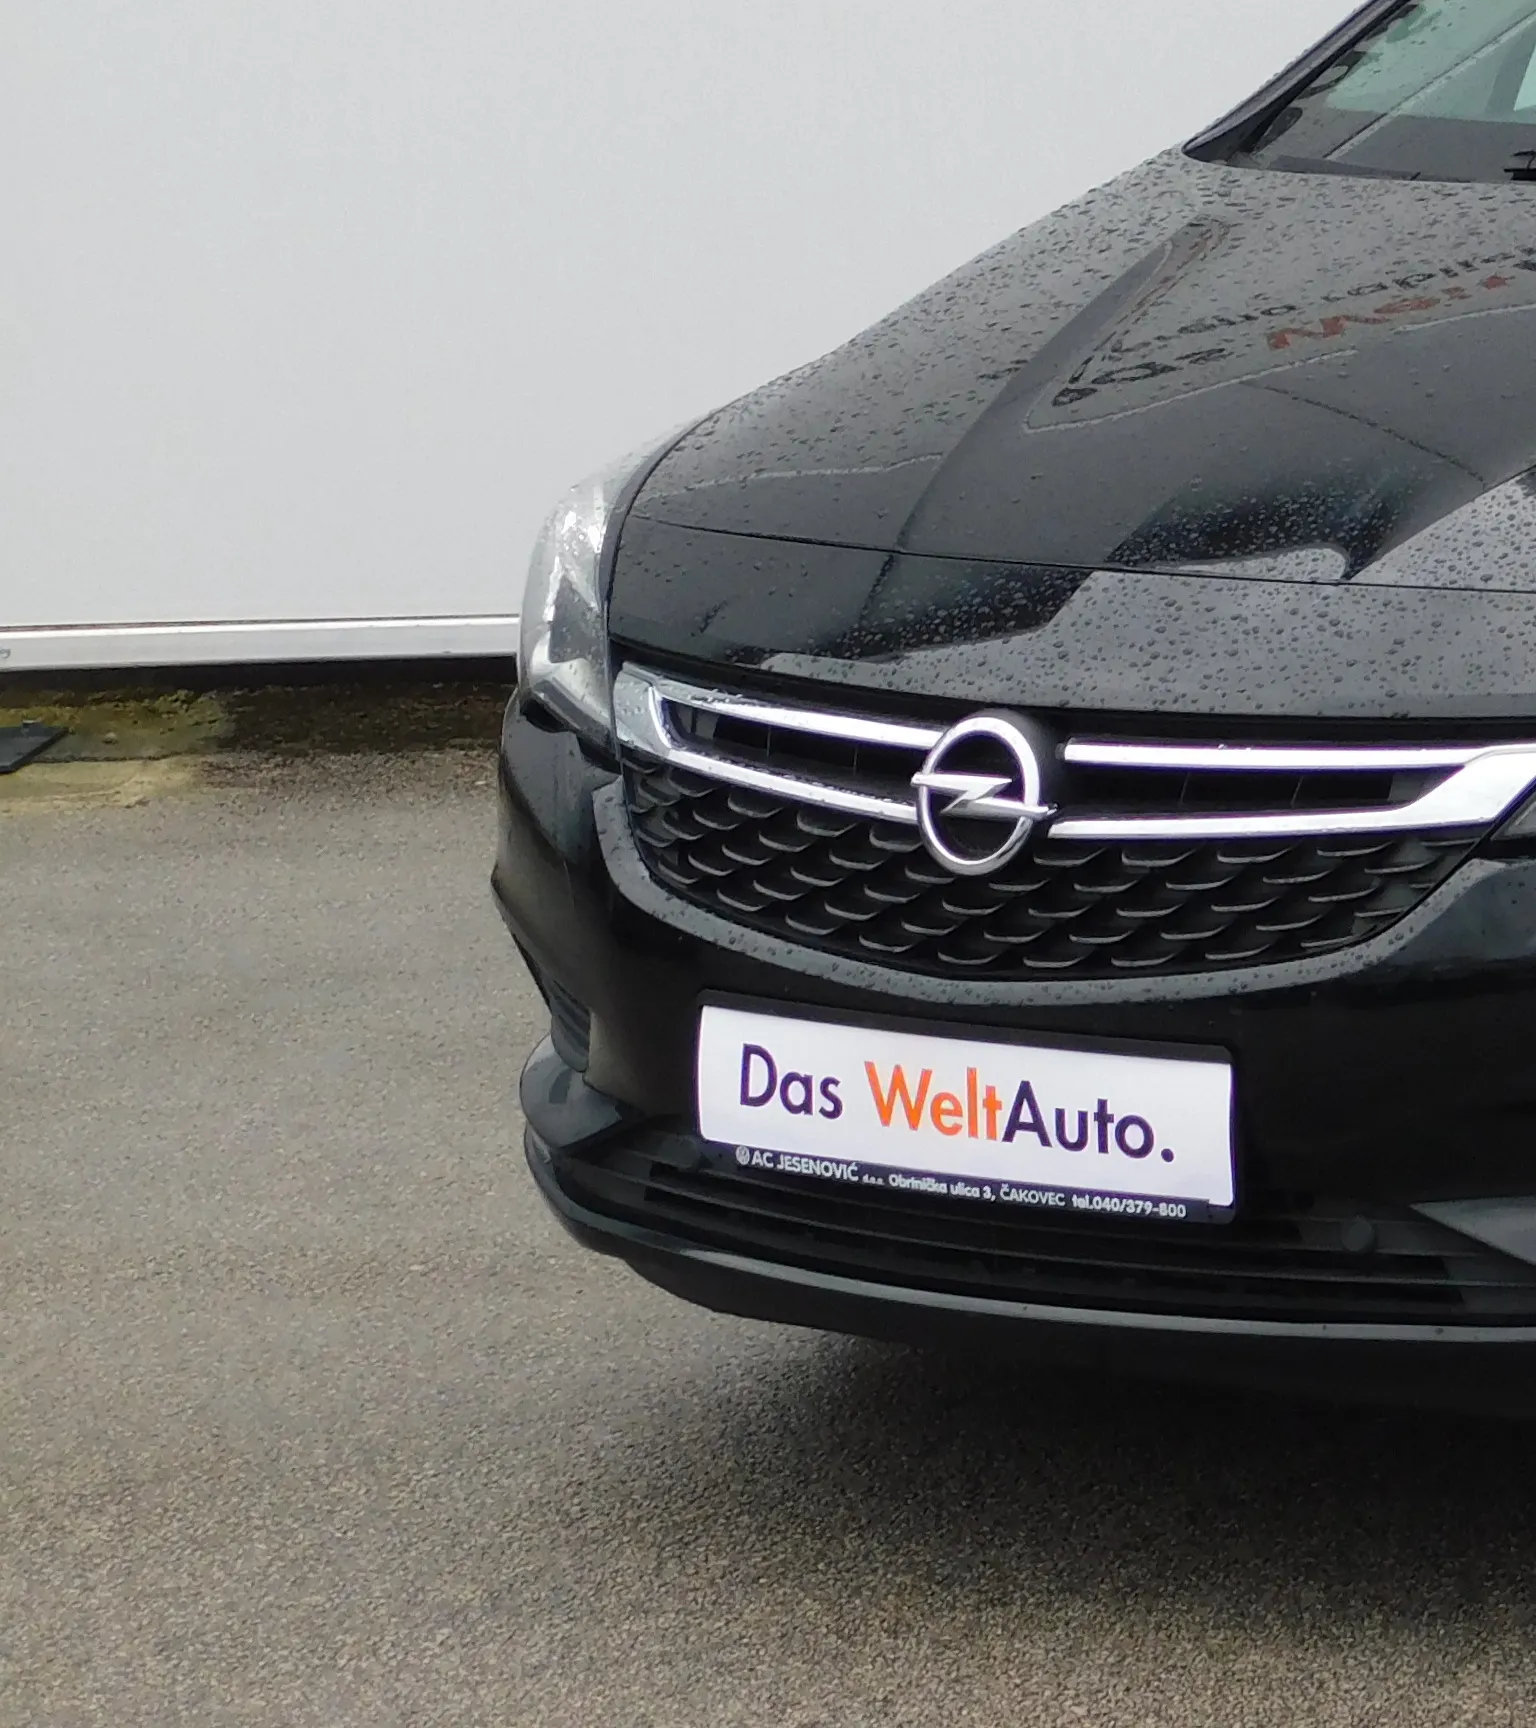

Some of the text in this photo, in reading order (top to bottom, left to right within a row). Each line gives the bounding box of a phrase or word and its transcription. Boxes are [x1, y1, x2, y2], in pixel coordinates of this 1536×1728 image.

[739, 1043, 1176, 1163] Das WeltAuto.
[751, 1150, 774, 1168] AC
[777, 1153, 859, 1181] JESENOVIĆ
[950, 1181, 980, 1198] ulica
[1000, 1182, 1066, 1207] ČAKOVEC
[1072, 1193, 1187, 1219] tel.040/379-800
